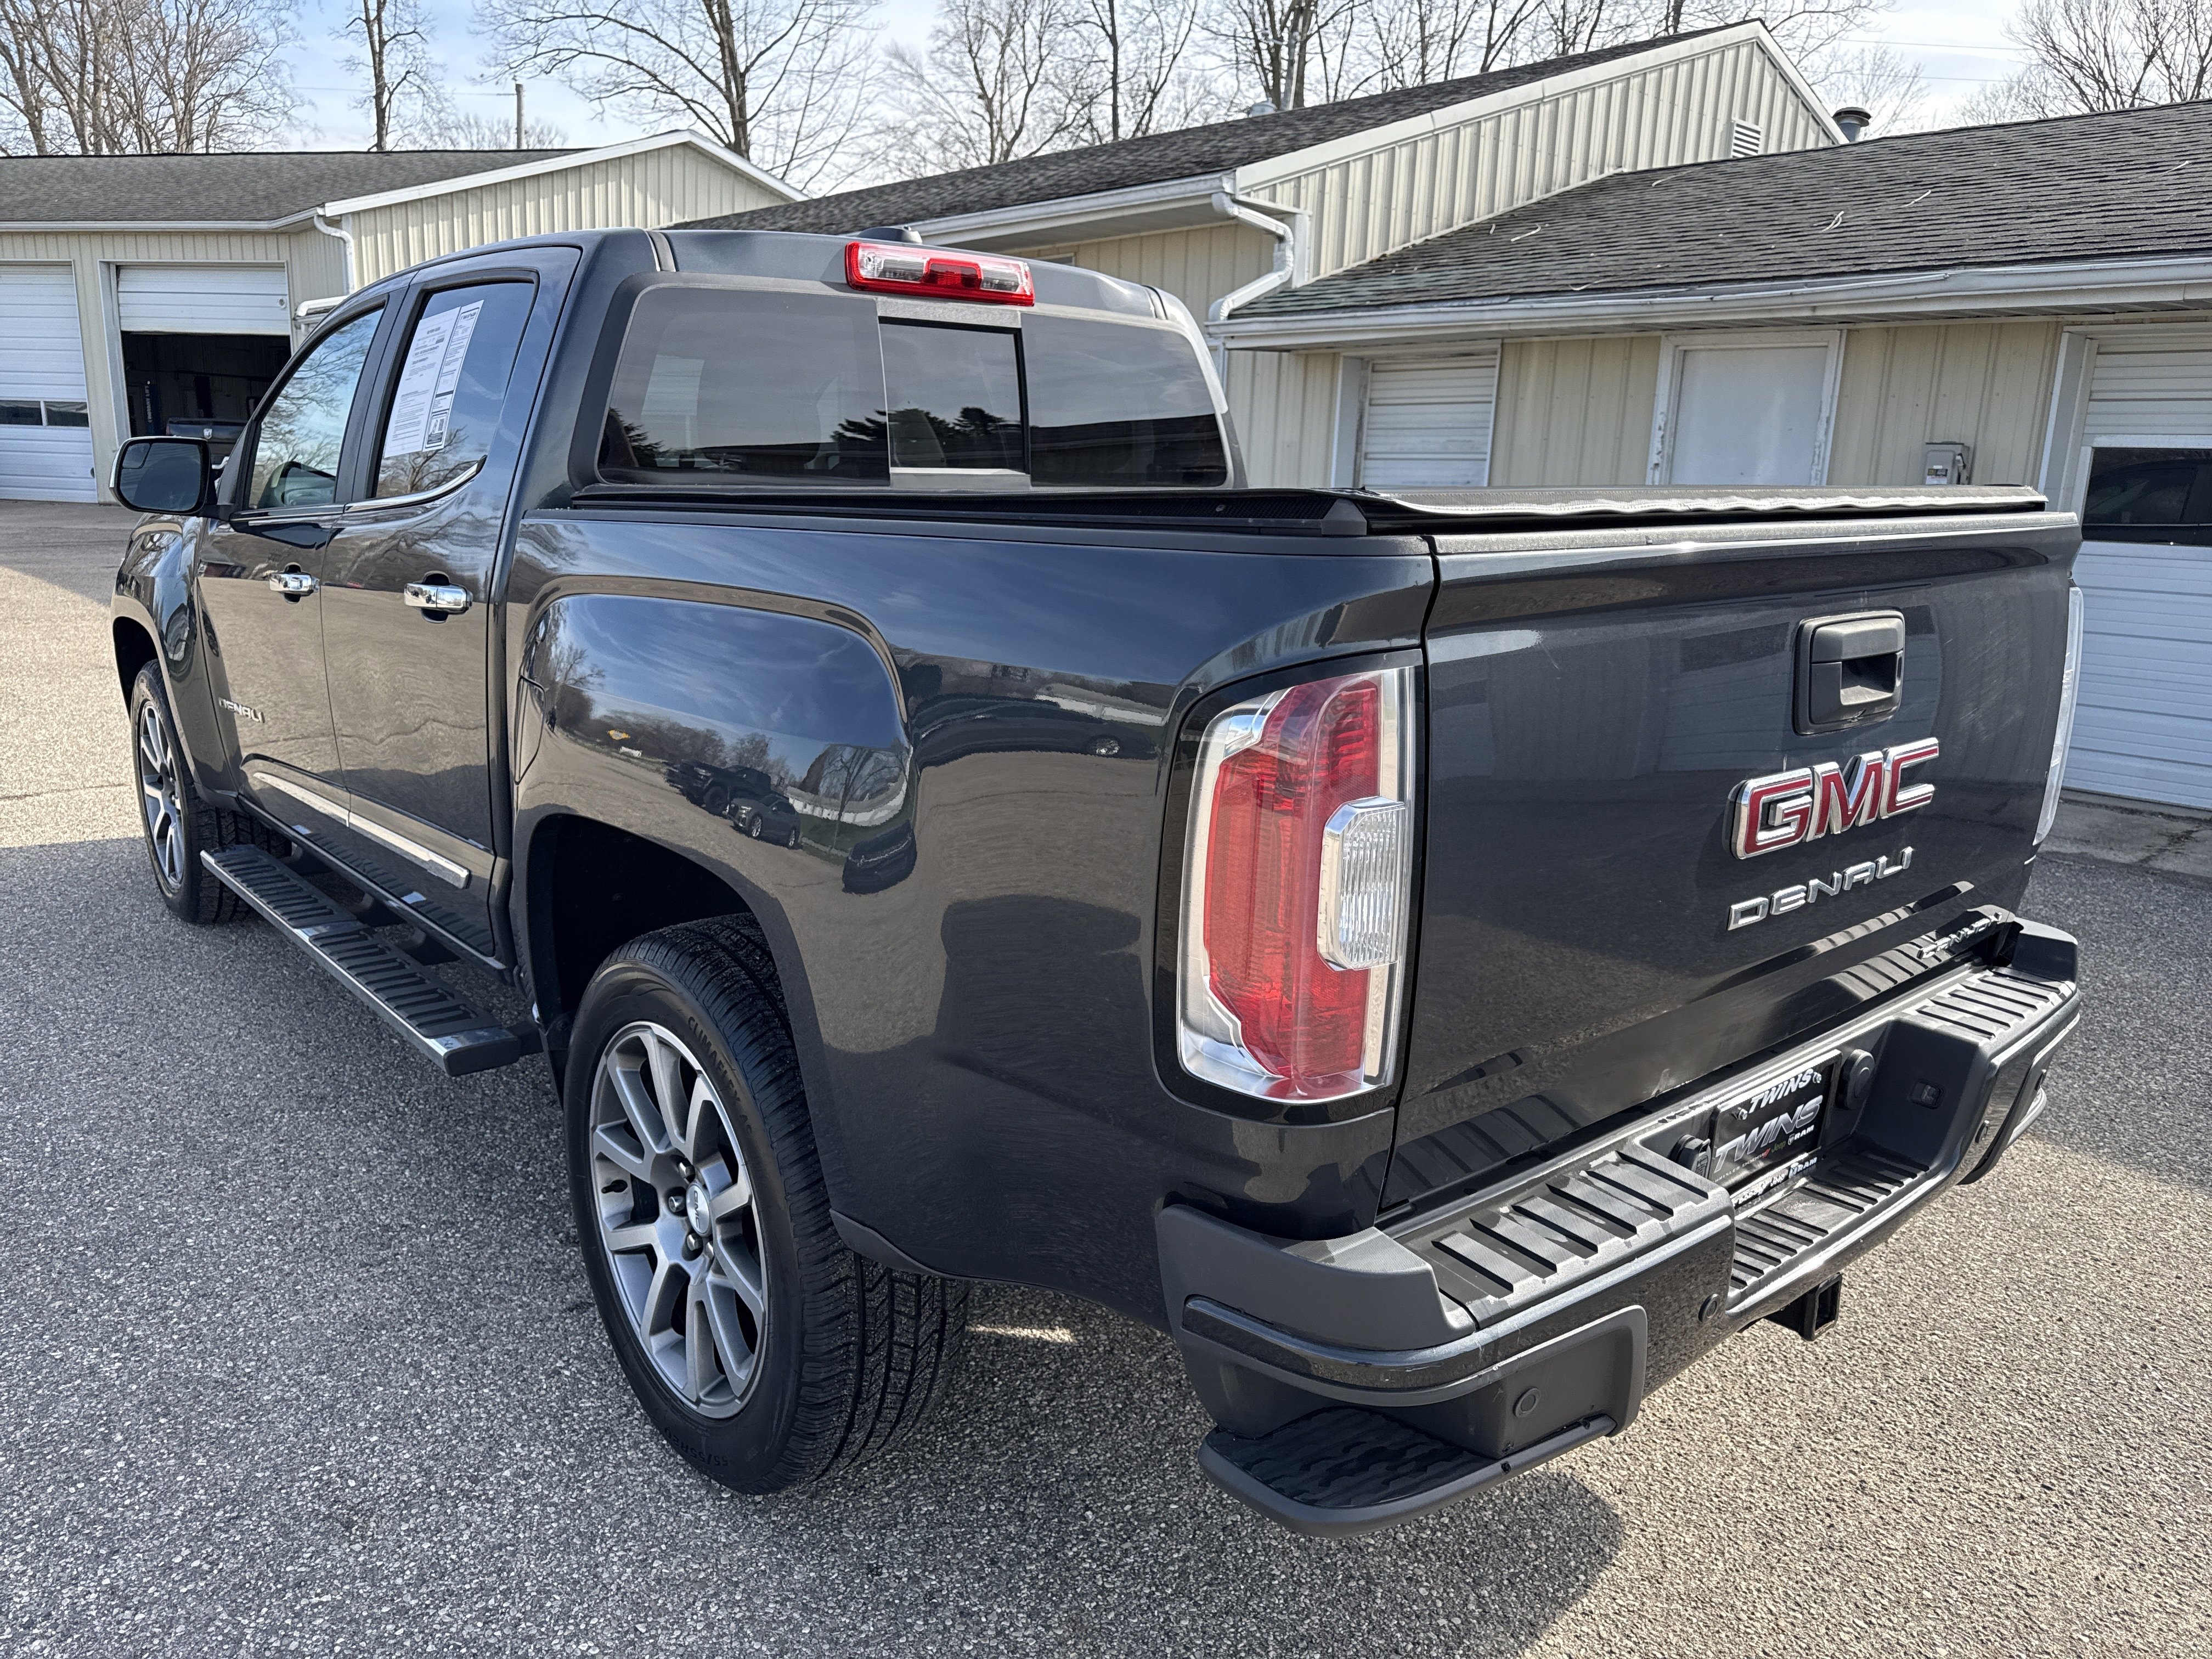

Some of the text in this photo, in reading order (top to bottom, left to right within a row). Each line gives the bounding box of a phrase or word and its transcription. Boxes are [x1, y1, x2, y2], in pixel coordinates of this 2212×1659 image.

[218, 696, 266, 724] DENALI
[1724, 737, 1939, 860] GMC
[1727, 846, 1914, 931] DENALI
[1748, 1068, 1814, 1114] TWINS
[1713, 1094, 1823, 1173] TWINS
[1771, 1140, 1787, 1153] Jeep
[1793, 1124, 1815, 1141] RAM
[1797, 1156, 1818, 1171] RAM
[663, 1426, 734, 1466] 55/55R20
